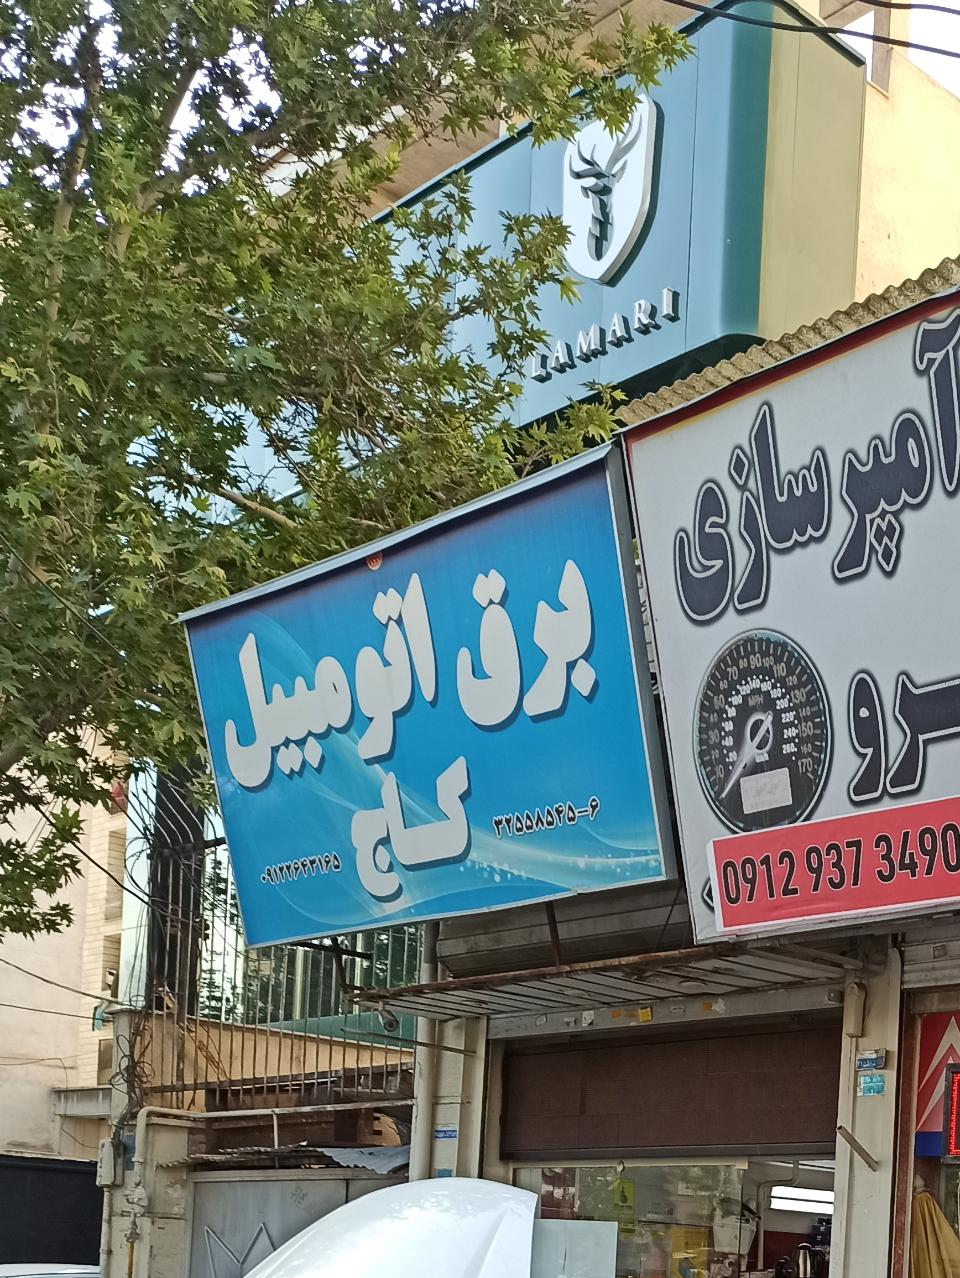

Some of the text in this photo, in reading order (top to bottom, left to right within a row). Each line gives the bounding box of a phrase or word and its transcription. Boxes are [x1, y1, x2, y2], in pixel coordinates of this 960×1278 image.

[529, 287, 680, 383] LAMARI
[674, 402, 829, 623] سازی
[224, 559, 597, 788] برق اتومبیل
[351, 756, 468, 899] کاج
[721, 849, 800, 905] 0912
[804, 837, 864, 894] 937
